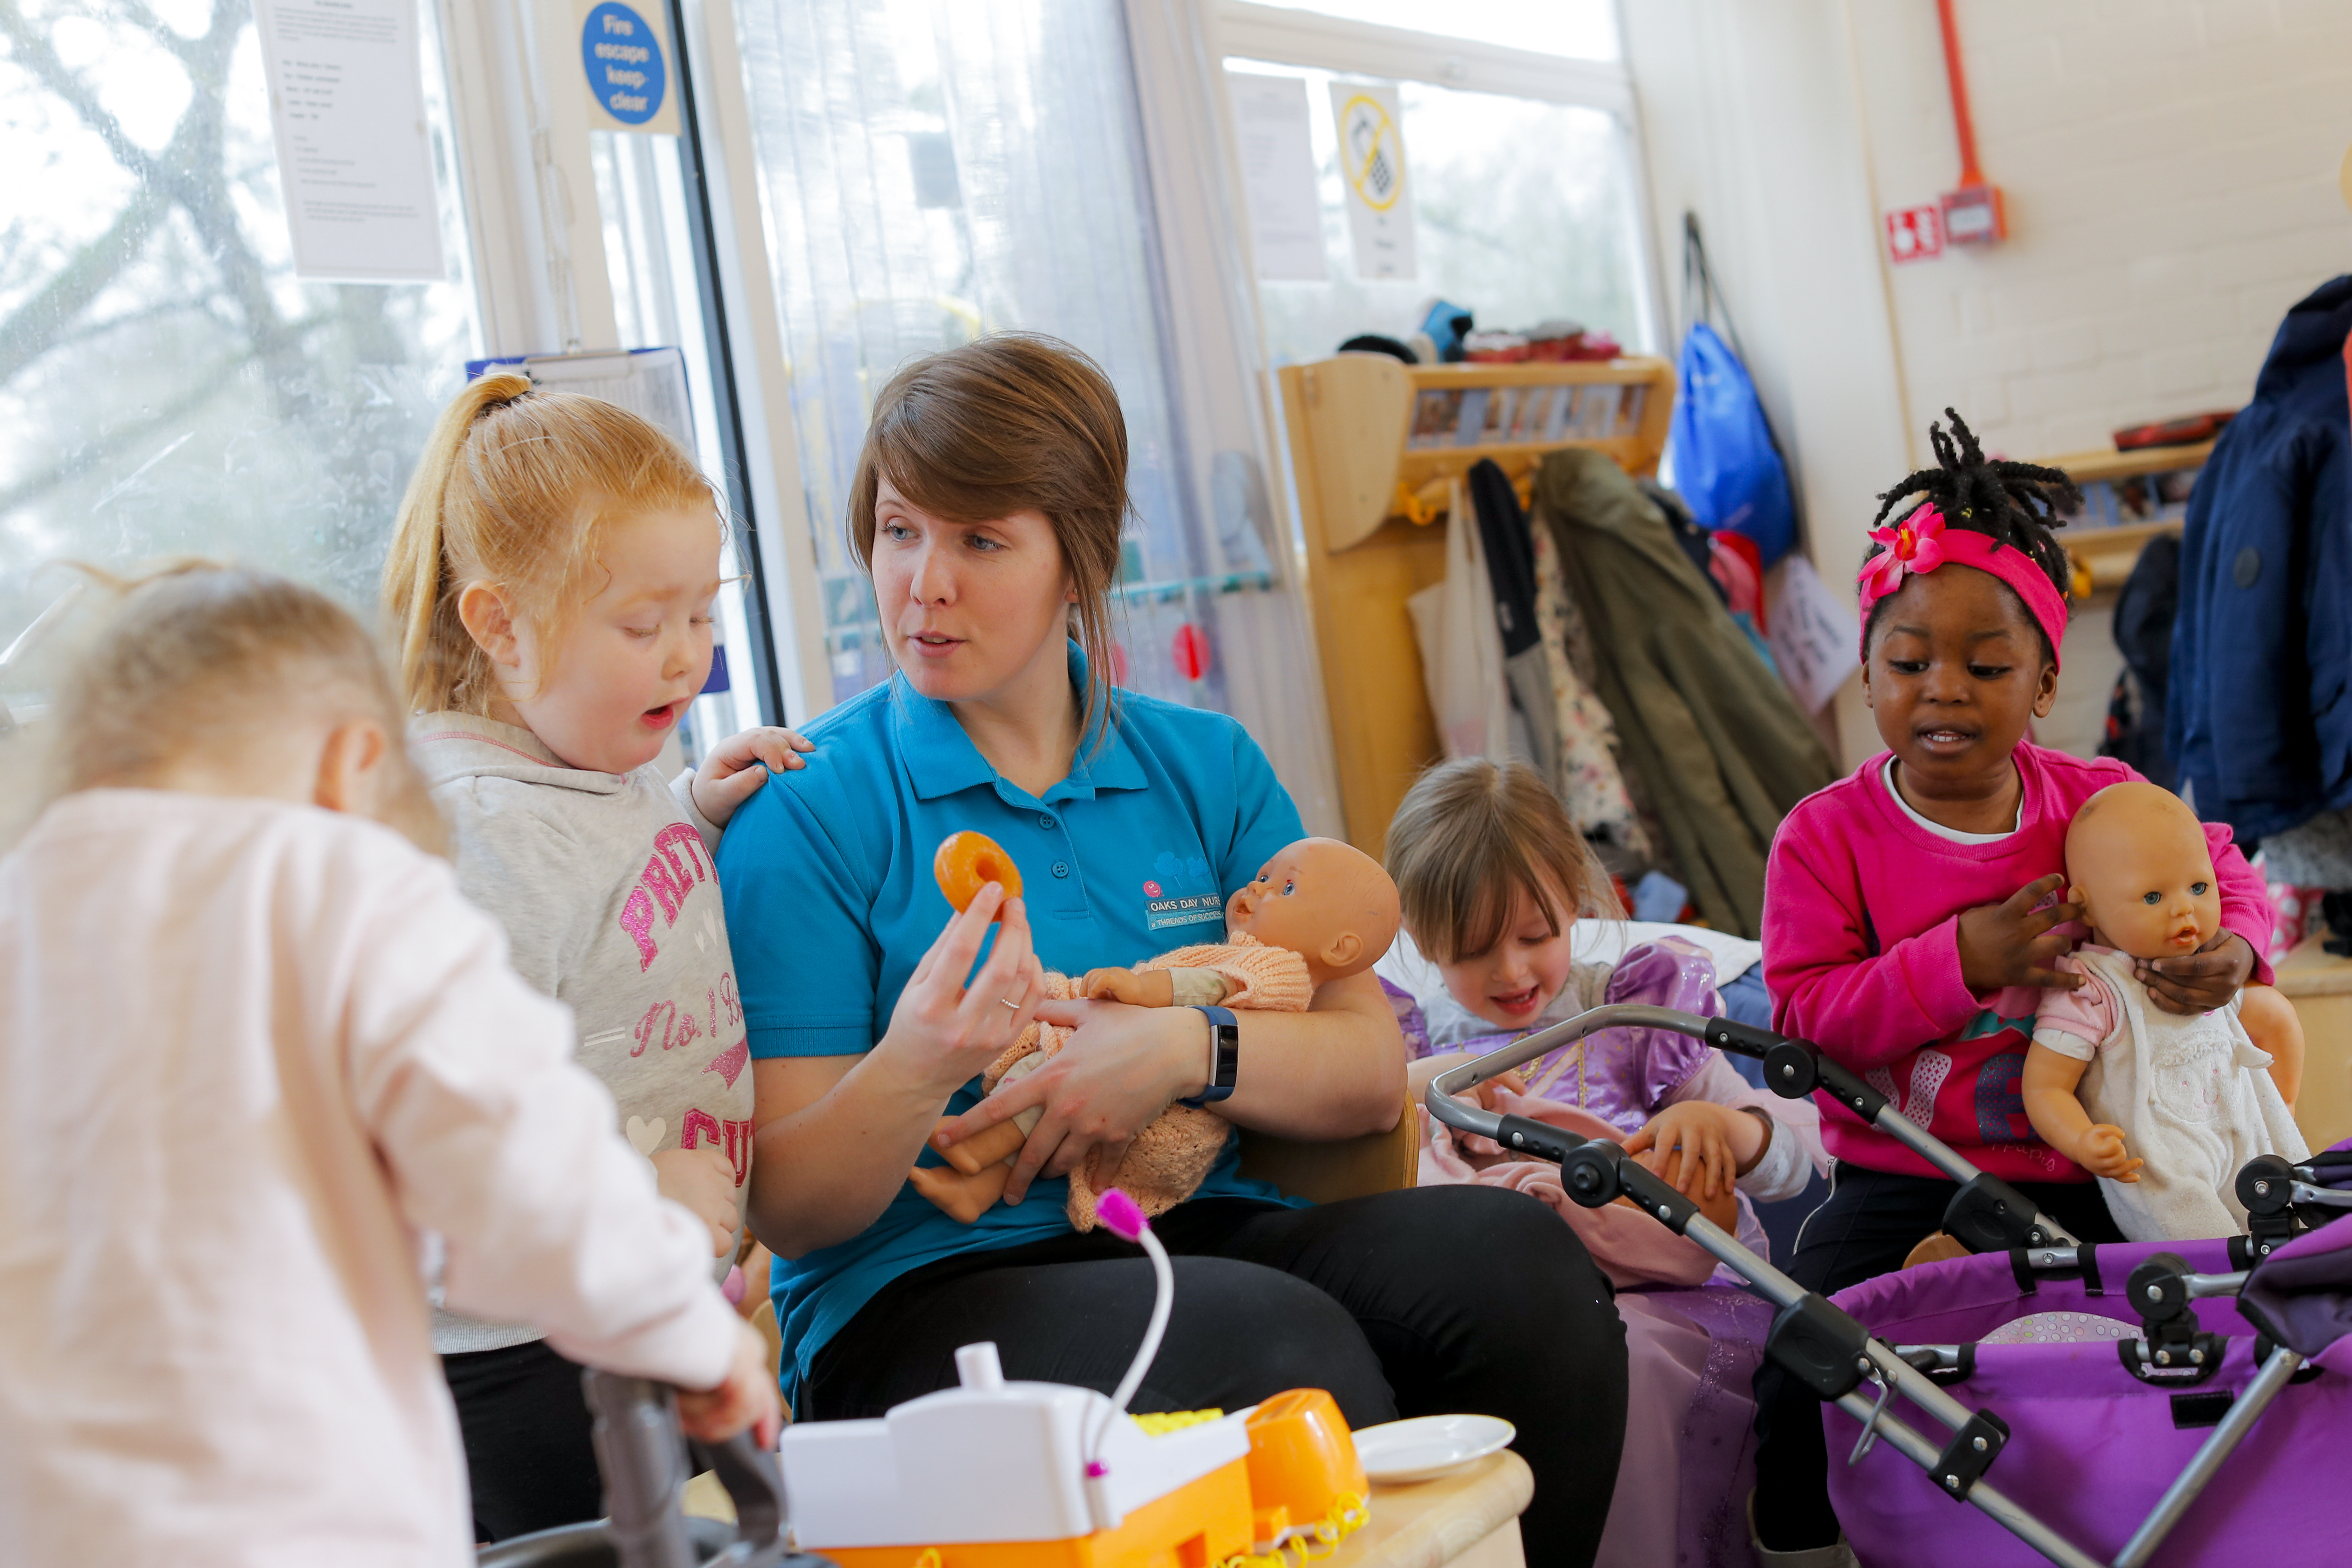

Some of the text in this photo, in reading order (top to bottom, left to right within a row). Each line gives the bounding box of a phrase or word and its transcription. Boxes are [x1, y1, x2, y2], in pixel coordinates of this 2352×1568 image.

[603, 14, 634, 37] Fire
[594, 42, 650, 64] escape
[609, 90, 649, 112] clear
[1150, 900, 1178, 912] OAKS
[1180, 898, 1198, 909] DAY
[1156, 916, 1188, 926] THREADS
[1188, 914, 1197, 922] OF
[680, 1108, 755, 1188] CU
